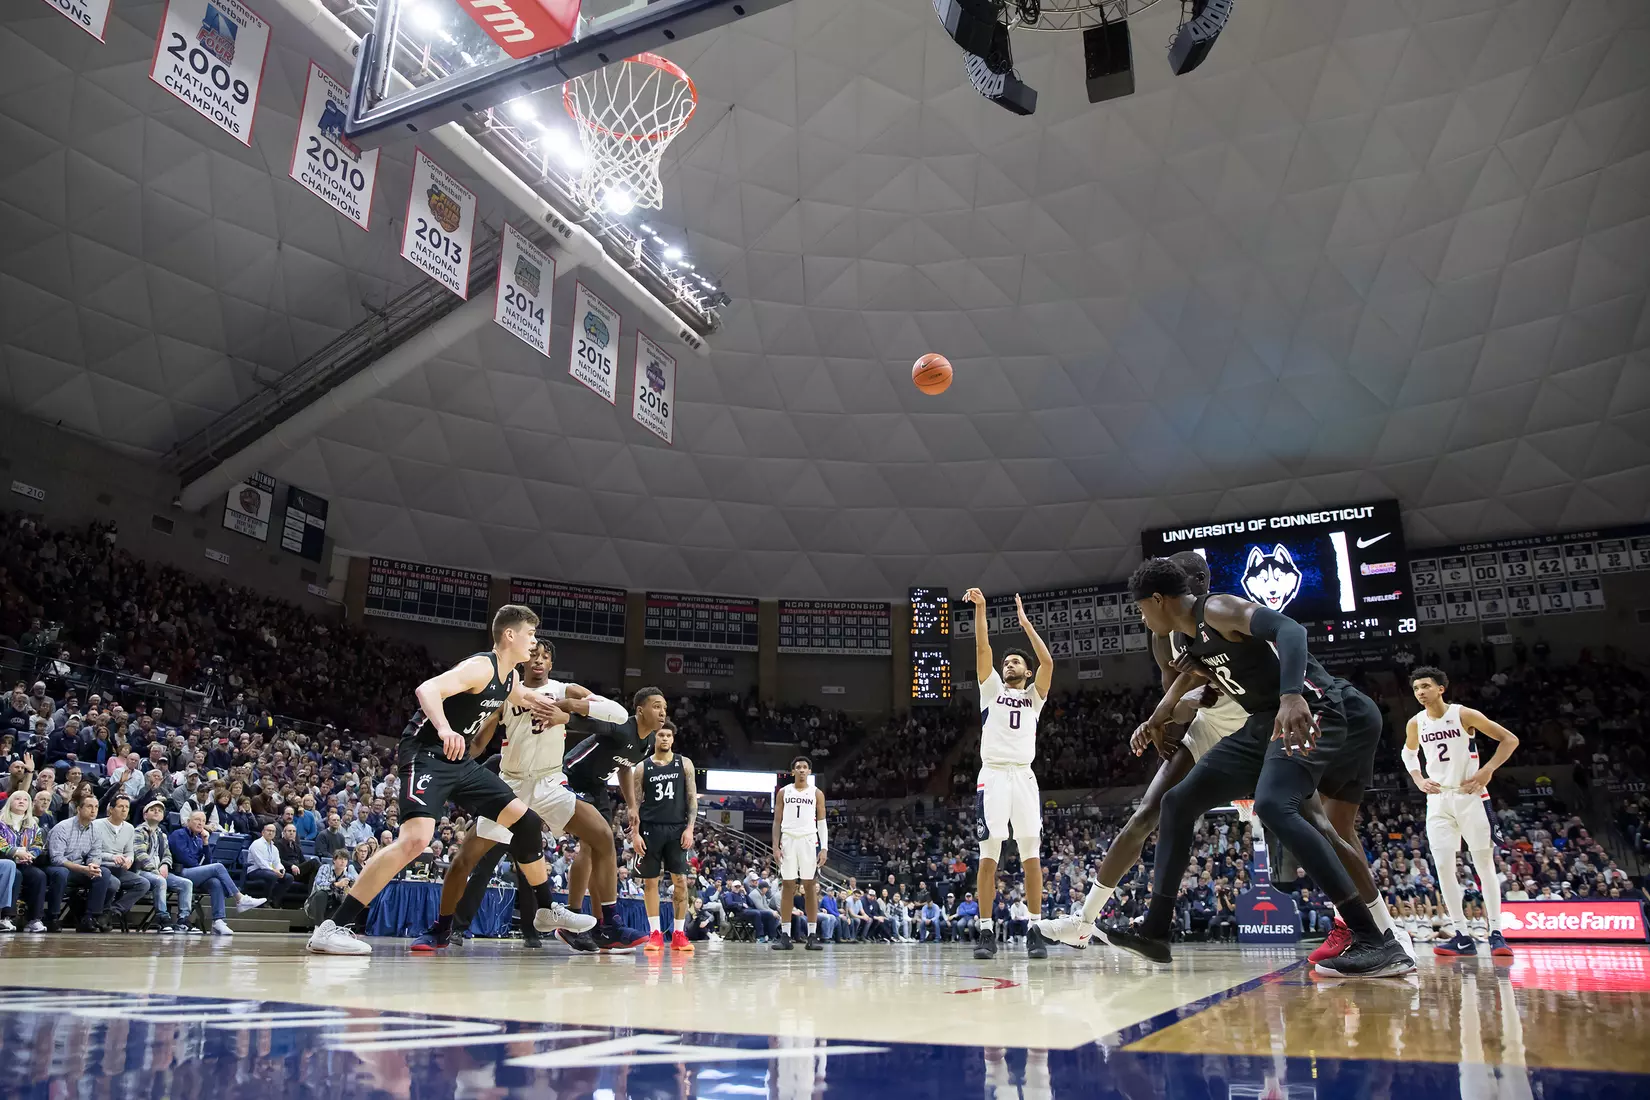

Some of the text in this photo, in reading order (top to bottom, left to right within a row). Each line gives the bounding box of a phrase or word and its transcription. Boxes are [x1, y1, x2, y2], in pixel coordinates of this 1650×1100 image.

[166, 32, 249, 105] 2009
[173, 64, 237, 117] NATIONAL
[317, 70, 343, 96] UConn
[164, 75, 240, 134] CHAMPIONS
[306, 136, 365, 192] 2010
[421, 155, 443, 177] UConn
[307, 162, 359, 206] NATIONAL
[430, 173, 462, 202] Basketball
[301, 173, 361, 220] CHAMPIONS
[414, 217, 462, 265] 2013
[415, 241, 457, 277] NATIONAL
[410, 251, 460, 291] CHAMPIONS
[504, 284, 545, 326] 2014
[505, 306, 542, 337] NATIONAL
[501, 316, 544, 349] CHAMPIONS
[577, 339, 611, 376] 2015
[578, 360, 609, 387] NATIONAL
[574, 369, 611, 399] CHAMPIONS
[639, 386, 669, 419] 2016
[639, 404, 667, 429] NATIONAL
[636, 412, 669, 440] CHAMPIONS
[27, 487, 44, 499] 210
[1162, 506, 1375, 544] UNIVERSITY OF CONNECTICUT
[1460, 544, 1493, 553] UCONN
[219, 552, 230, 563] 211
[371, 558, 489, 583] BIG EAST CONFERENCE
[1476, 567, 1497, 580] 00
[1508, 564, 1527, 577] 13
[1539, 560, 1561, 573] 42
[1415, 573, 1436, 586] 52
[1072, 587, 1099, 596] HONOR
[814, 602, 885, 610] CHAMPIONSHIP
[1548, 595, 1563, 607] 13
[1075, 609, 1092, 621] 44
[1426, 607, 1437, 619] 15
[1454, 604, 1468, 616] 22
[1051, 612, 1068, 624] 42
[1397, 618, 1416, 633] 28
[959, 622, 970, 633] C
[1360, 631, 1365, 639] 2
[1052, 642, 1070, 654] 24
[1078, 640, 1092, 652] 13
[1101, 637, 1118, 649] 22
[996, 695, 1033, 708] UCONN
[225, 716, 245, 731] 109
[1009, 710, 1021, 730] 0
[1421, 728, 1461, 743] UCONN
[1436, 742, 1451, 762] 2
[649, 773, 679, 783] CINCINNATI
[654, 781, 675, 800] 34
[1536, 786, 1554, 796] 116
[785, 797, 814, 806] UCONN
[796, 806, 800, 819] 1
[1237, 924, 1295, 935] TRAVELERS
